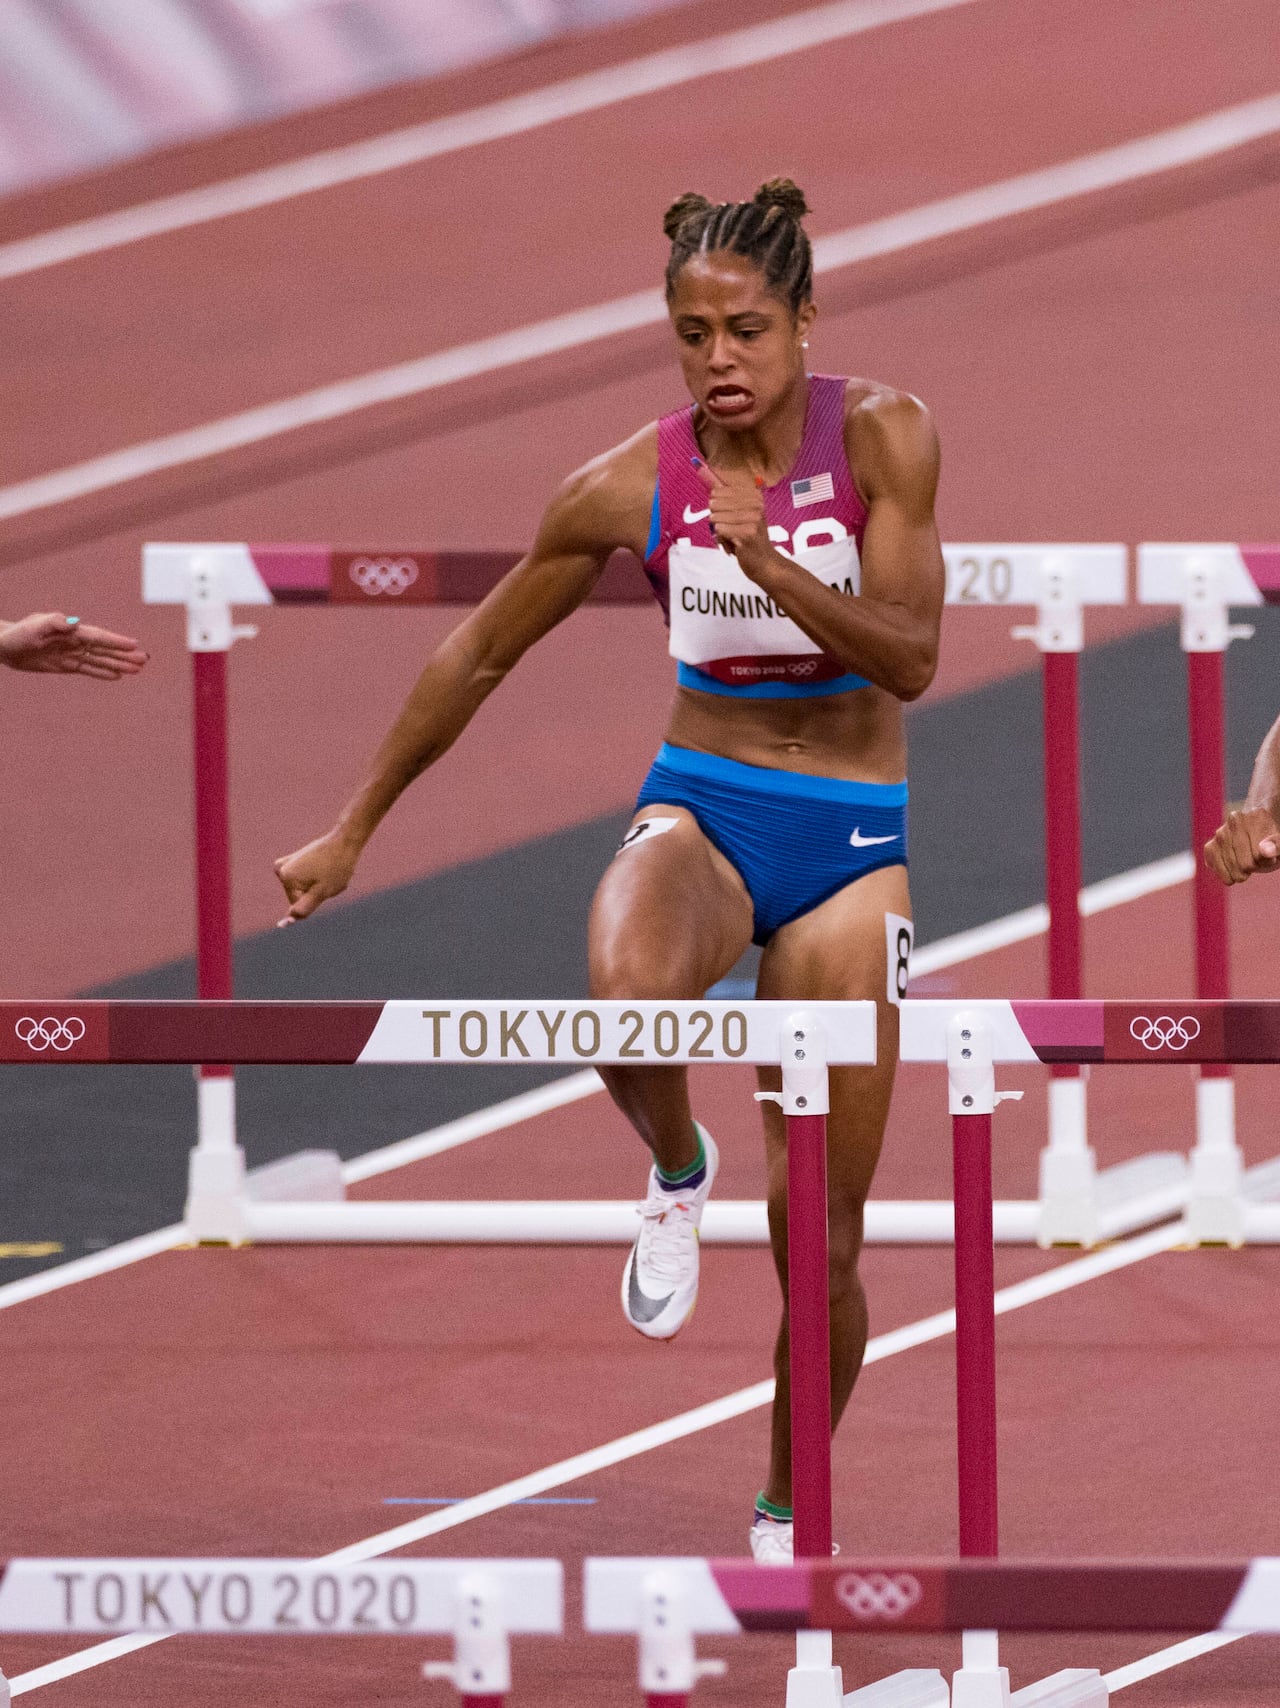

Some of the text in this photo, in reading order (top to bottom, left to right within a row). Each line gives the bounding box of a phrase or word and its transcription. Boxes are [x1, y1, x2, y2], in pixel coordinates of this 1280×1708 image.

[896, 927, 911, 999] 8
[422, 1010, 748, 1058] TOKYO 2020
[53, 1571, 418, 1627] TOKYO 2020
